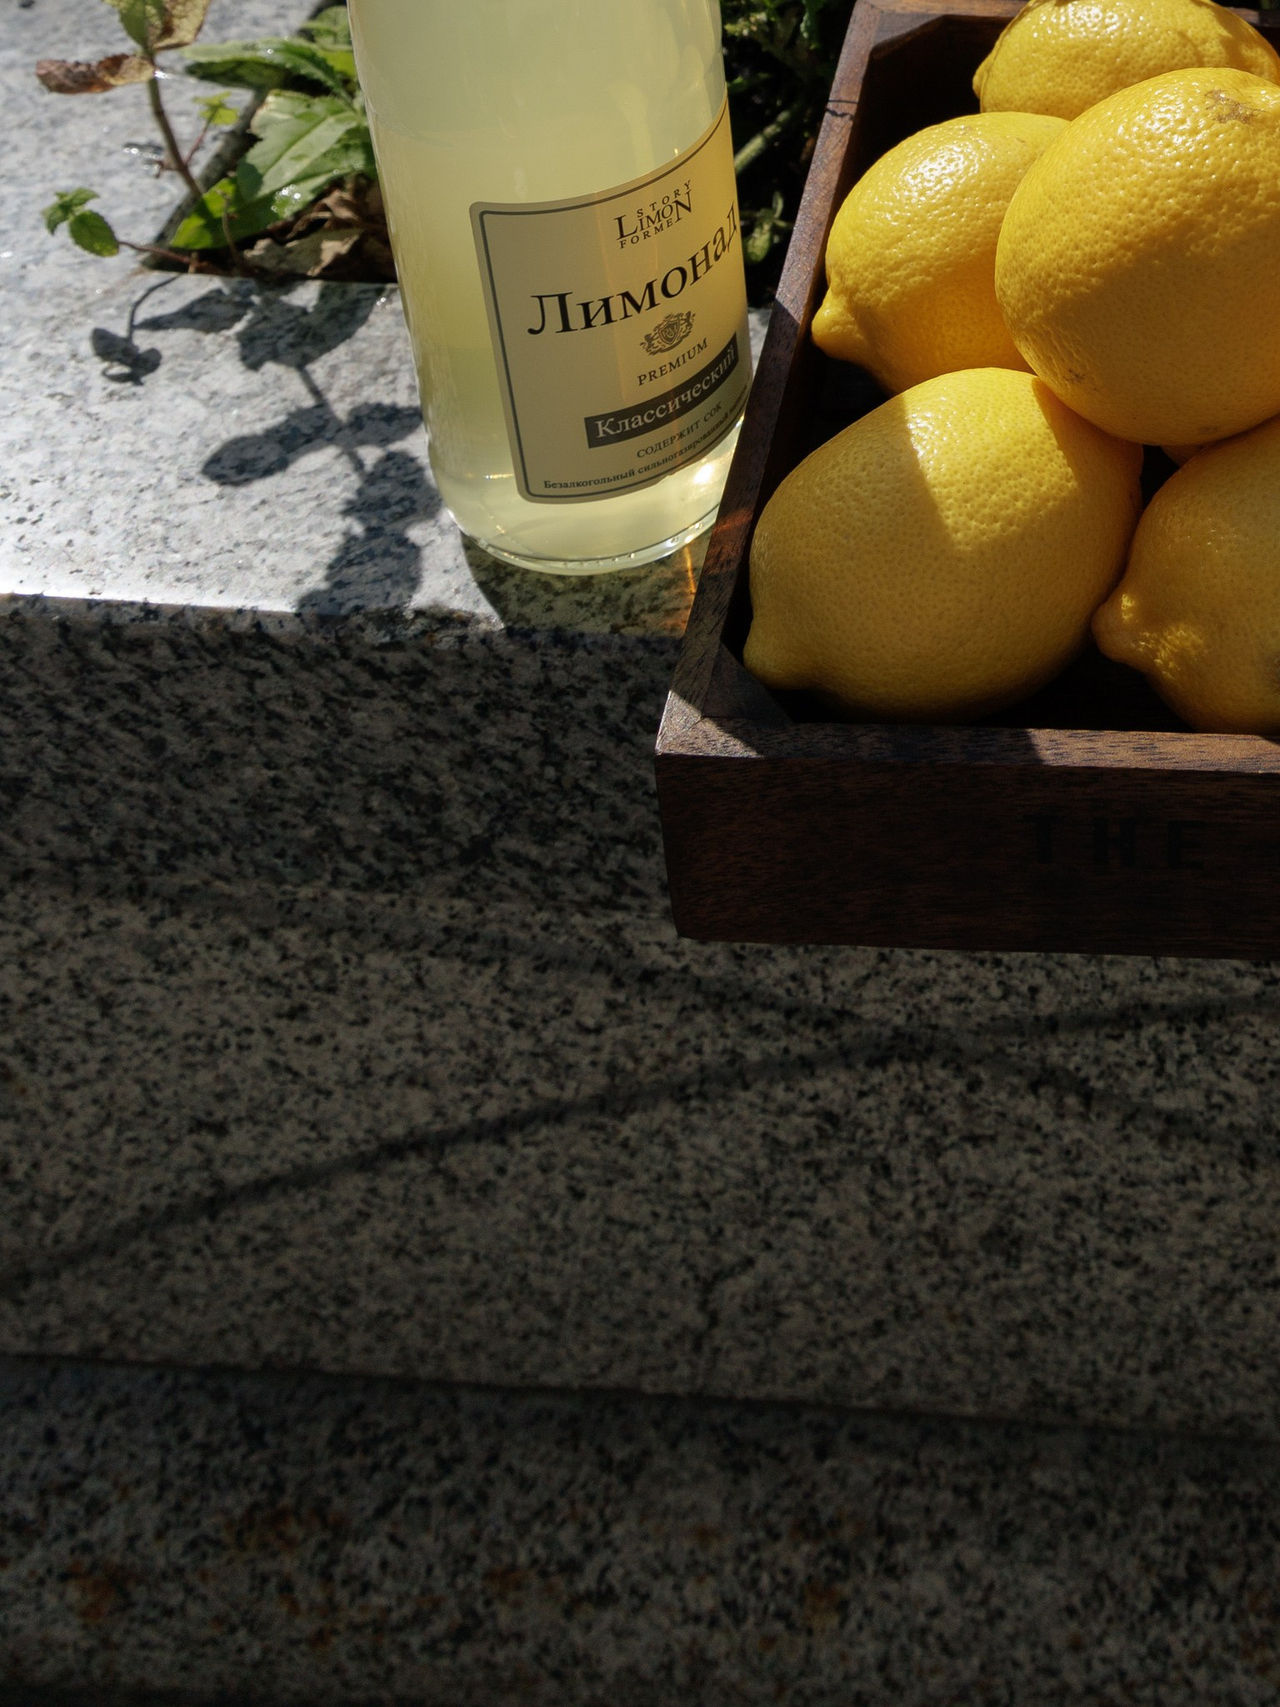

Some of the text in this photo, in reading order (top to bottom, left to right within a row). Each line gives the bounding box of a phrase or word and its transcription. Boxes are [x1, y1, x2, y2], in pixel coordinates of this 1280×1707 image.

[636, 179, 692, 218] STORY
[527, 200, 738, 336] Лимонад
[638, 337, 708, 387] PREMIUM
[594, 344, 736, 440] Классический
[636, 401, 723, 459] СОДЕРЖИТ СОК
[543, 468, 636, 490] Безалкогольный
[1022, 813, 1207, 871] THE
